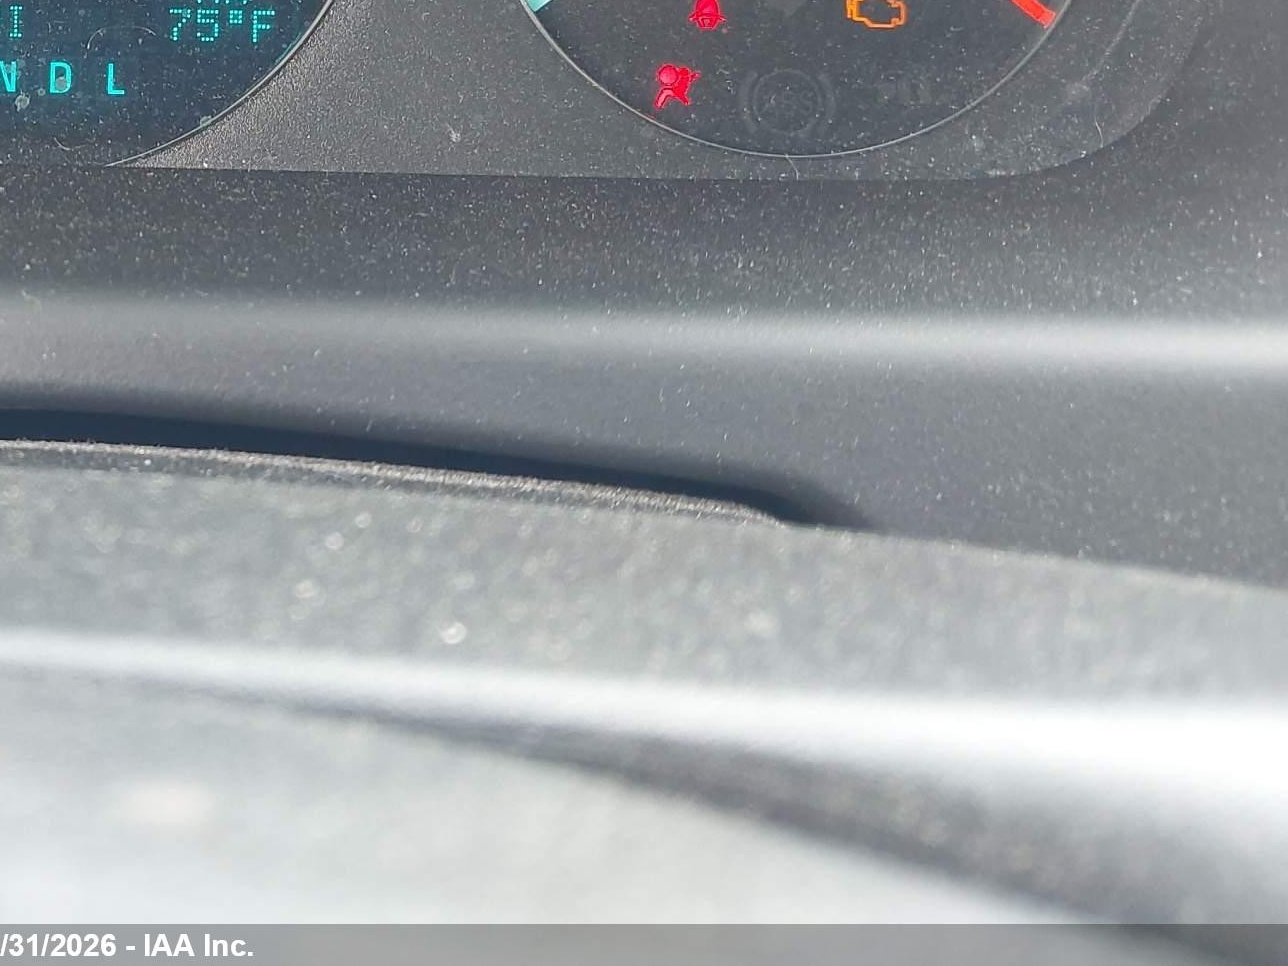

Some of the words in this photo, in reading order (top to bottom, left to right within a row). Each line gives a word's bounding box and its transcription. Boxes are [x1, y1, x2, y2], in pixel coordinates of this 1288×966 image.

[168, 8, 275, 43] 75°F
[49, 62, 74, 94] D
[106, 62, 125, 95] L
